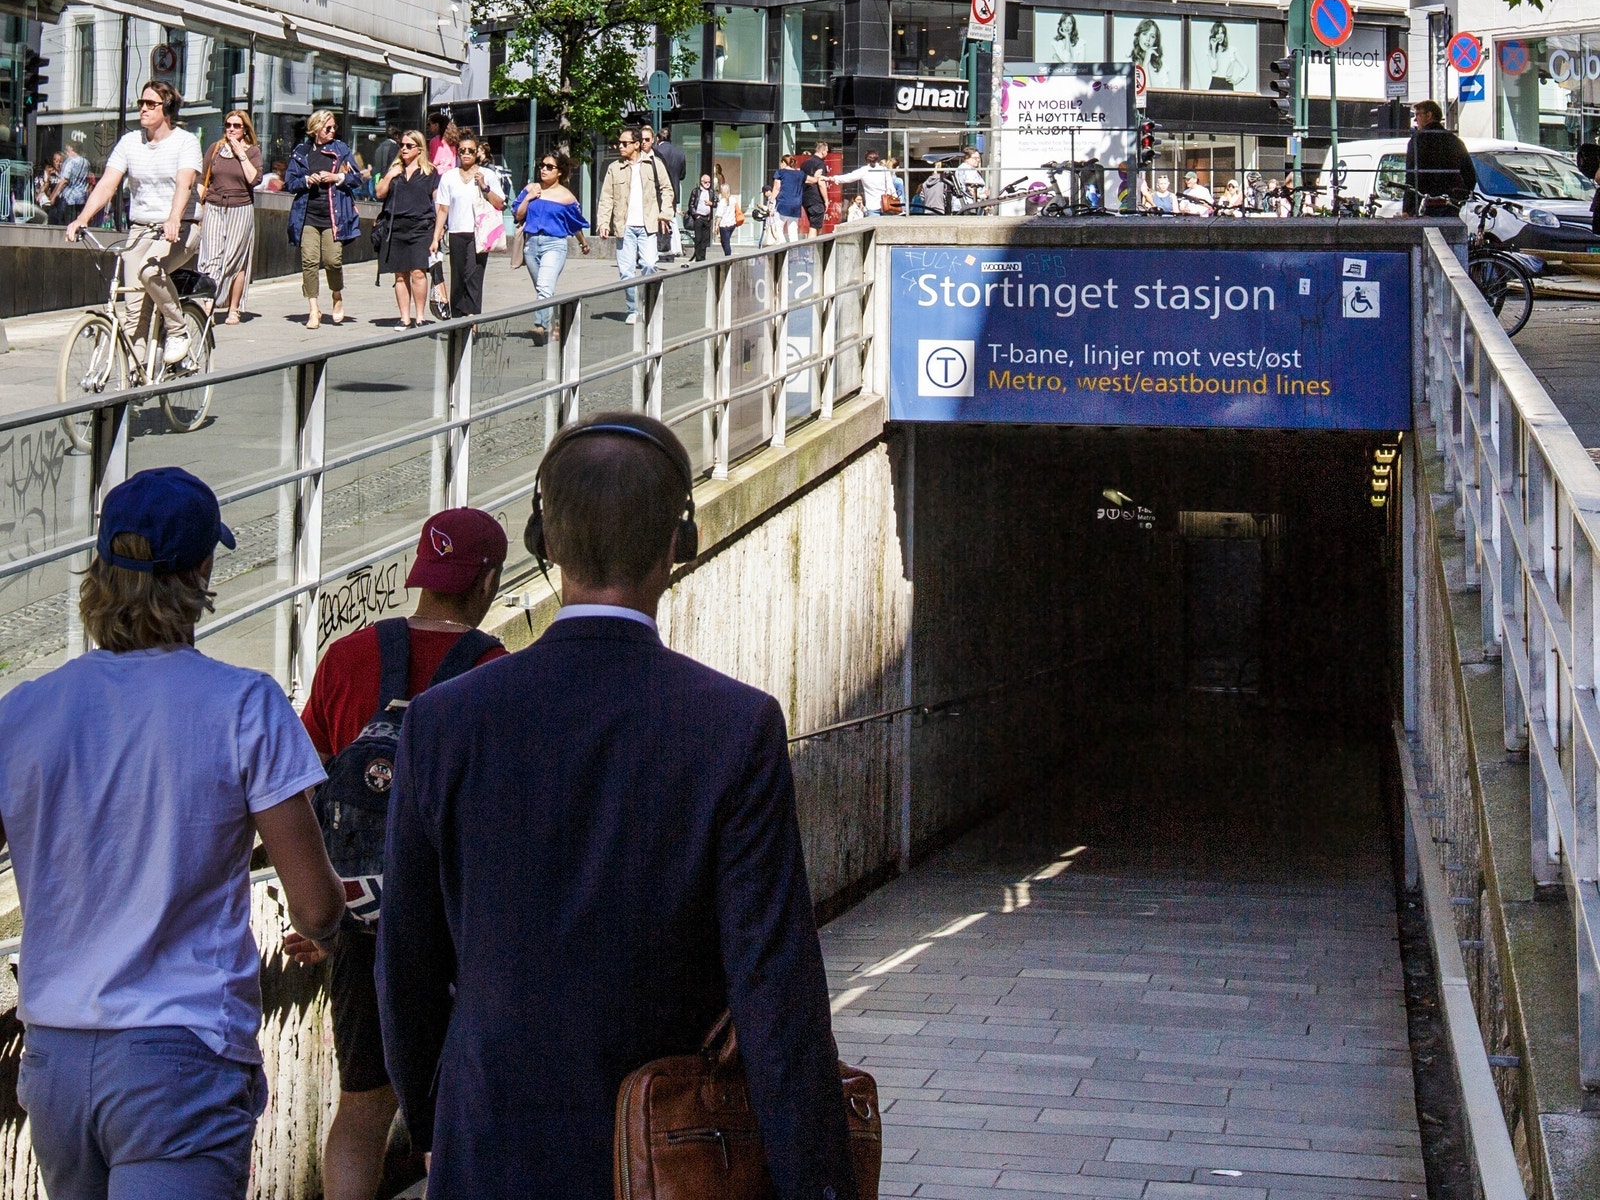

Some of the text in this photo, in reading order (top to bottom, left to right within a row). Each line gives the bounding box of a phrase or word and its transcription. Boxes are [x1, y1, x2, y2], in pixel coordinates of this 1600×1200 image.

[1549, 44, 1600, 83] Cub
[1018, 100, 1083, 110] NY MOBIL?
[1018, 111, 1106, 122] FÅ HØYTTALER
[1037, 125, 1083, 135] KJØPET
[982, 263, 1019, 271] WOODLAND
[917, 274, 1275, 320] Stortinget stasjon
[988, 343, 1302, 371] T-bane, linjer mot vest/øst
[936, 357, 956, 383] T
[988, 370, 1331, 395] Metro, west/eastbound lines
